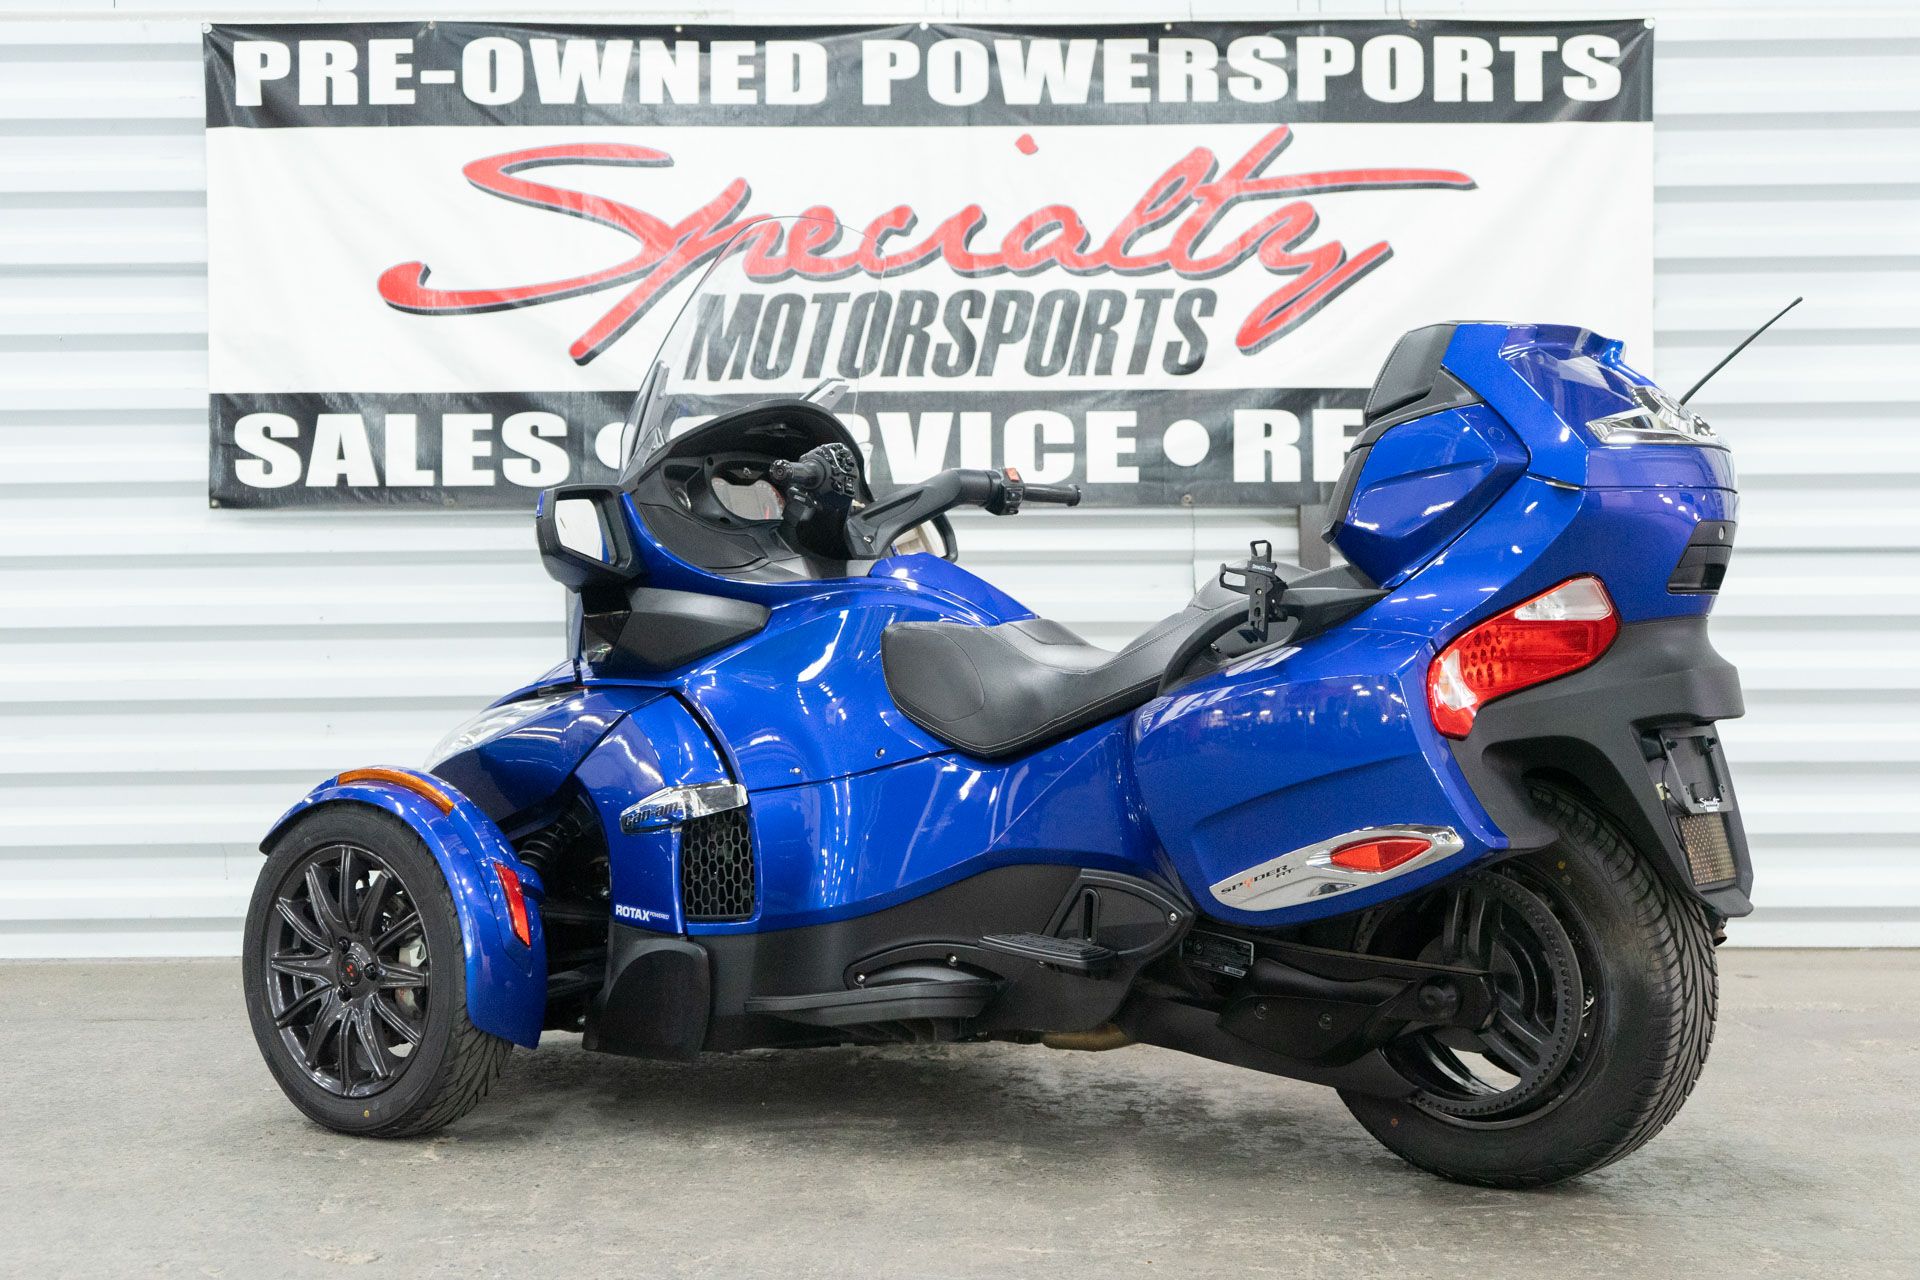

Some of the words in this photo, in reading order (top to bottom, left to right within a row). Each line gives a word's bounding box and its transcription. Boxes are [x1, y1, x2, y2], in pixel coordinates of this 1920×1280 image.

[233, 37, 828, 106] PRE-OWNED
[861, 34, 1622, 107] POWERSPORTS
[377, 126, 1478, 366] Specialty
[686, 289, 1218, 382] MOTORSPORTS
[234, 412, 570, 489] SALES
[669, 410, 1140, 486] VICE
[615, 904, 650, 922] ROTAX
